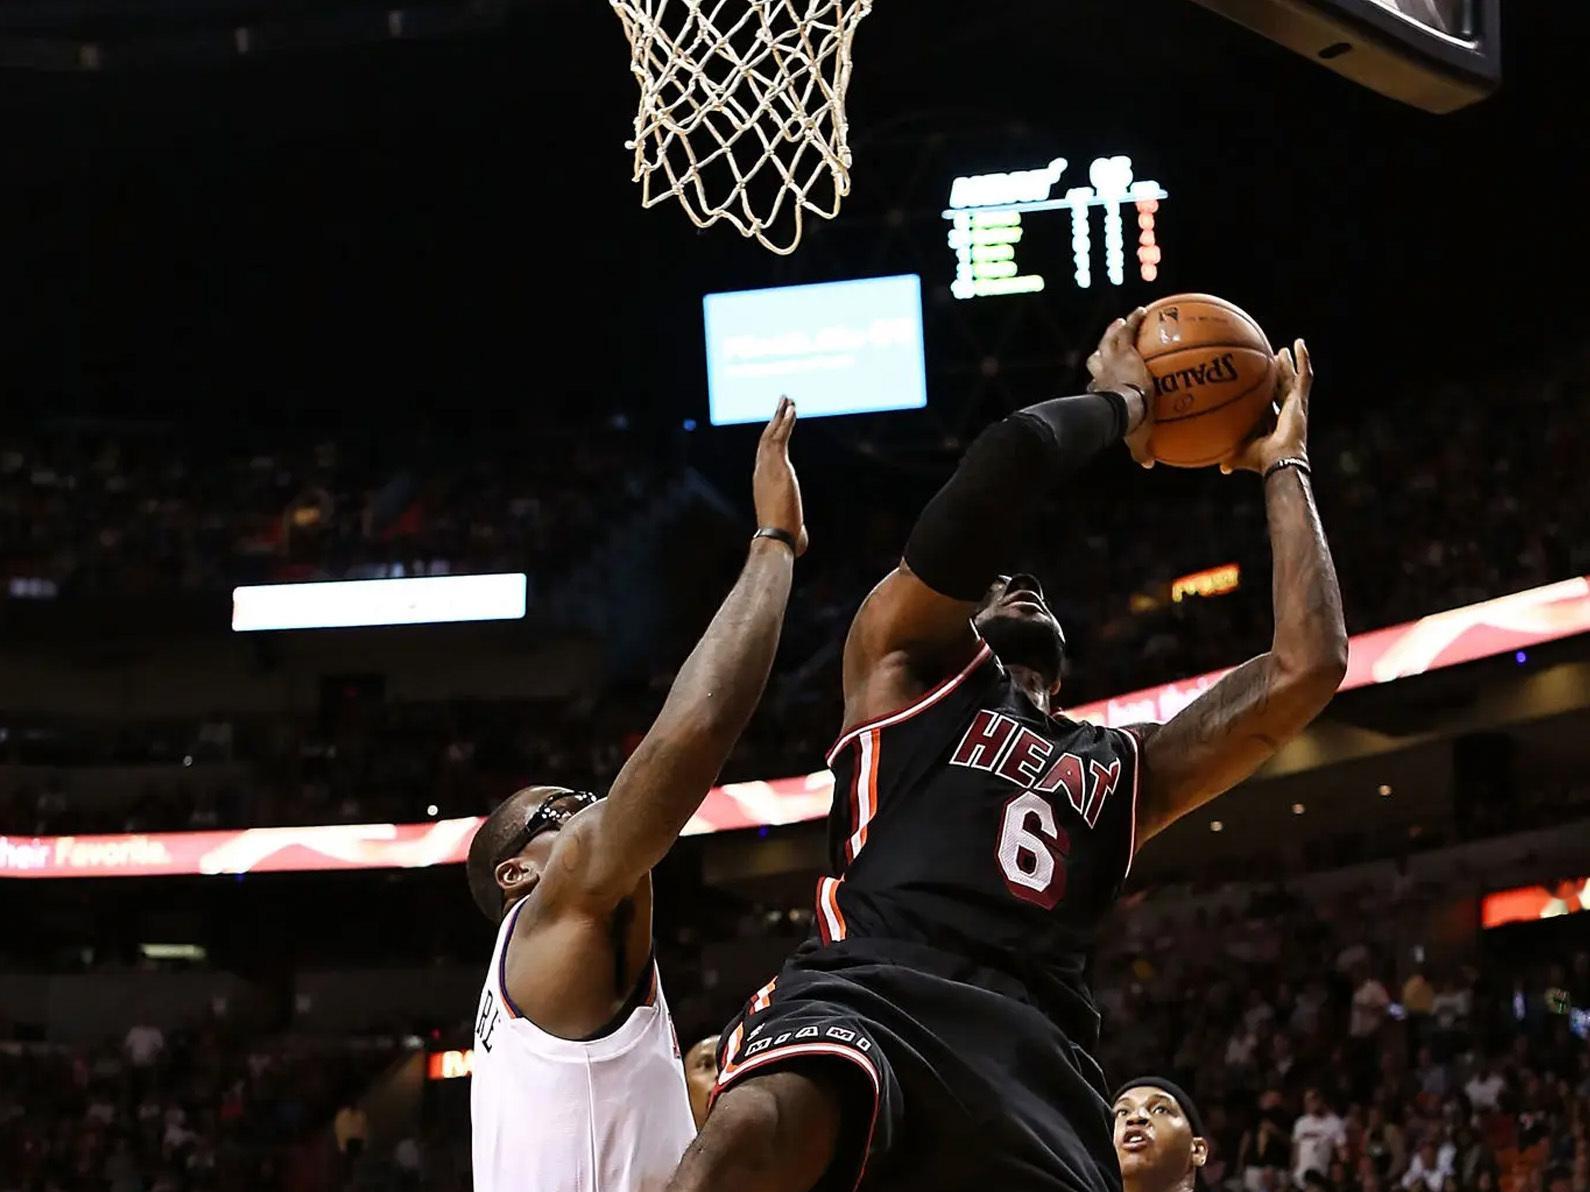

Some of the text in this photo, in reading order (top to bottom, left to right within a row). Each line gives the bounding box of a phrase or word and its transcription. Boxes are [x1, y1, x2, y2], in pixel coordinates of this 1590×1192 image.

[1152, 353, 1238, 396] SPALDI
[950, 709, 1121, 829] HEAT
[997, 789, 1067, 906] 6
